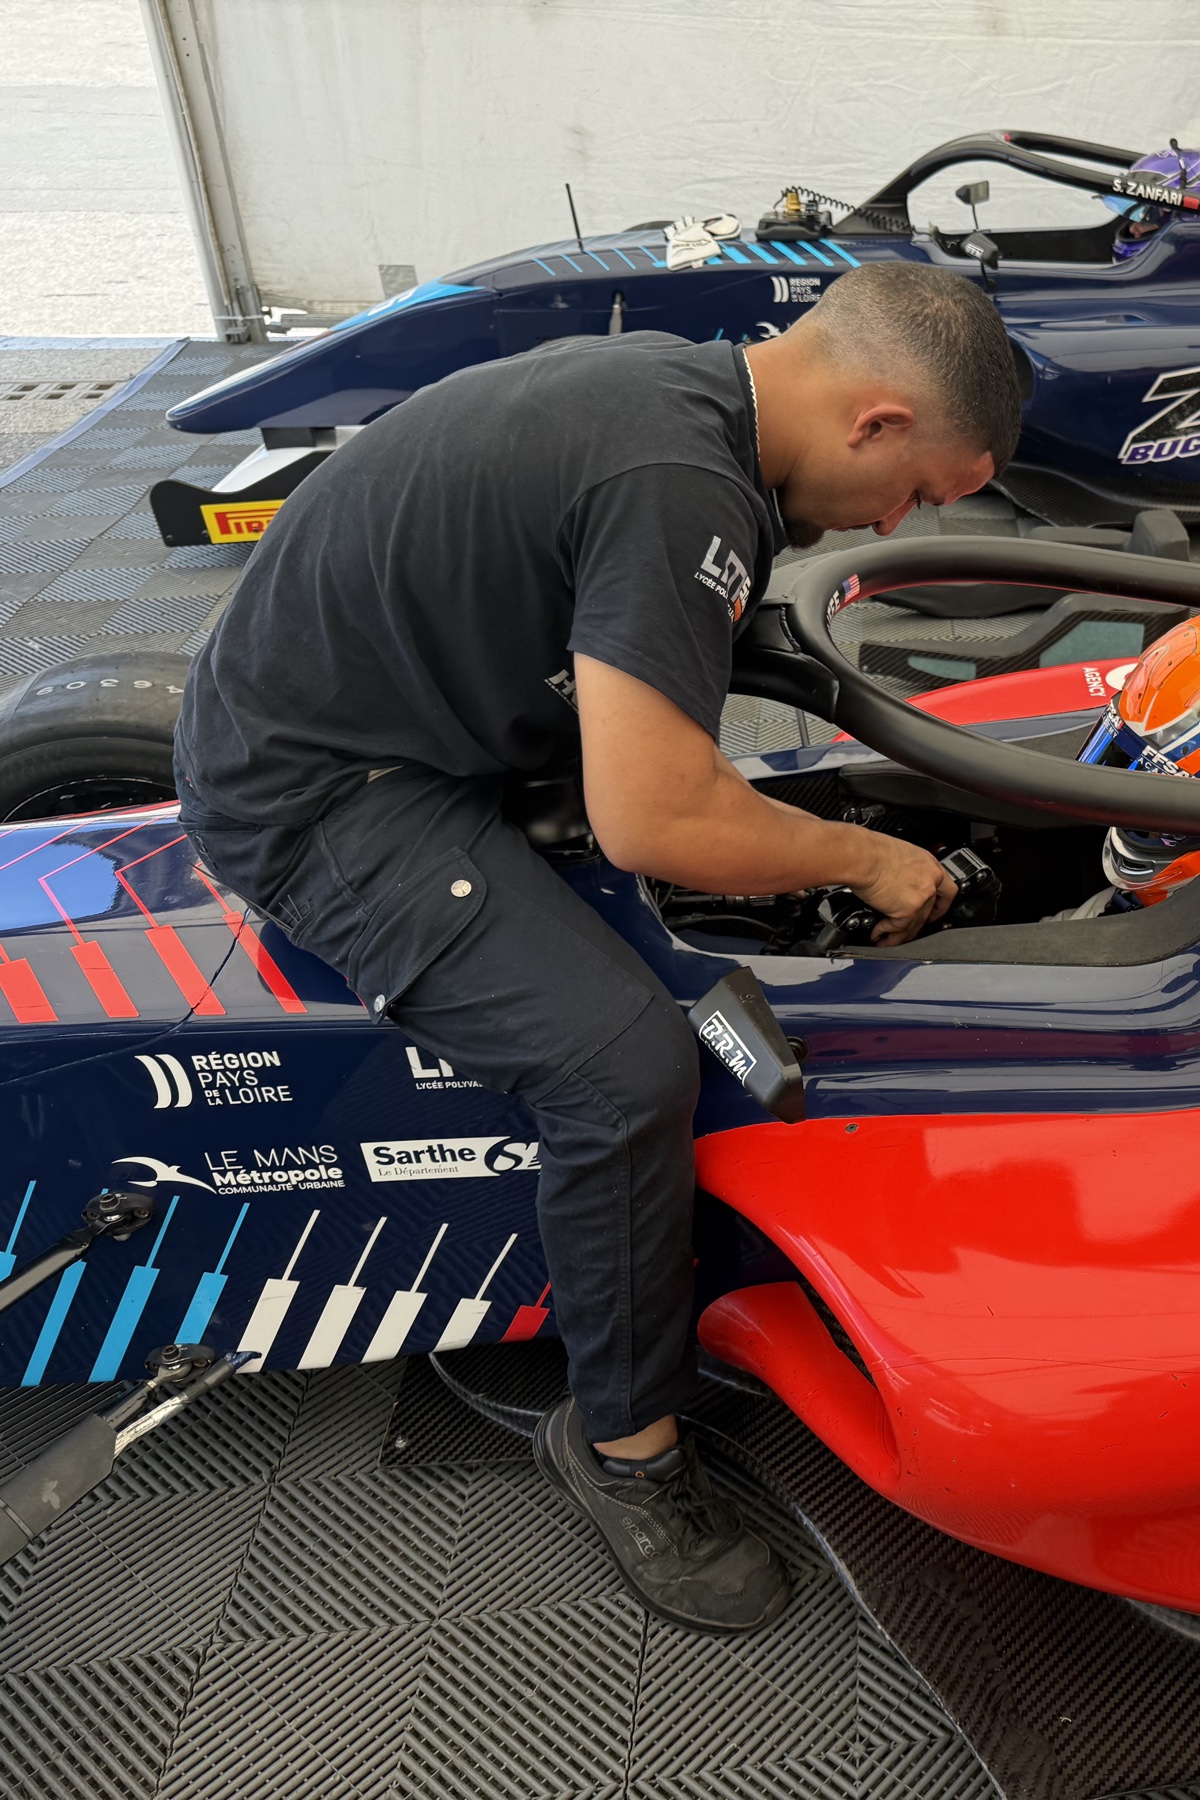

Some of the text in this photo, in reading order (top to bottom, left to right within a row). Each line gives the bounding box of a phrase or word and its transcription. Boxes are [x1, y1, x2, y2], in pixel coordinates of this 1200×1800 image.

[1112, 179, 1183, 206] S. ZANFARI
[1083, 667, 1106, 697] AGENCY
[191, 1051, 281, 1070] RÉGION
[198, 1070, 258, 1088] PAYS
[416, 1080, 444, 1089] LYCÉE
[225, 1086, 293, 1104] LOIRE
[204, 1145, 338, 1170] LE MANS
[373, 1144, 477, 1165] Sarthe
[212, 1165, 343, 1186] Métropole
[378, 1165, 459, 1176] Le Département
[218, 1180, 345, 1194] COMMUNAUTÉ URBAINE
